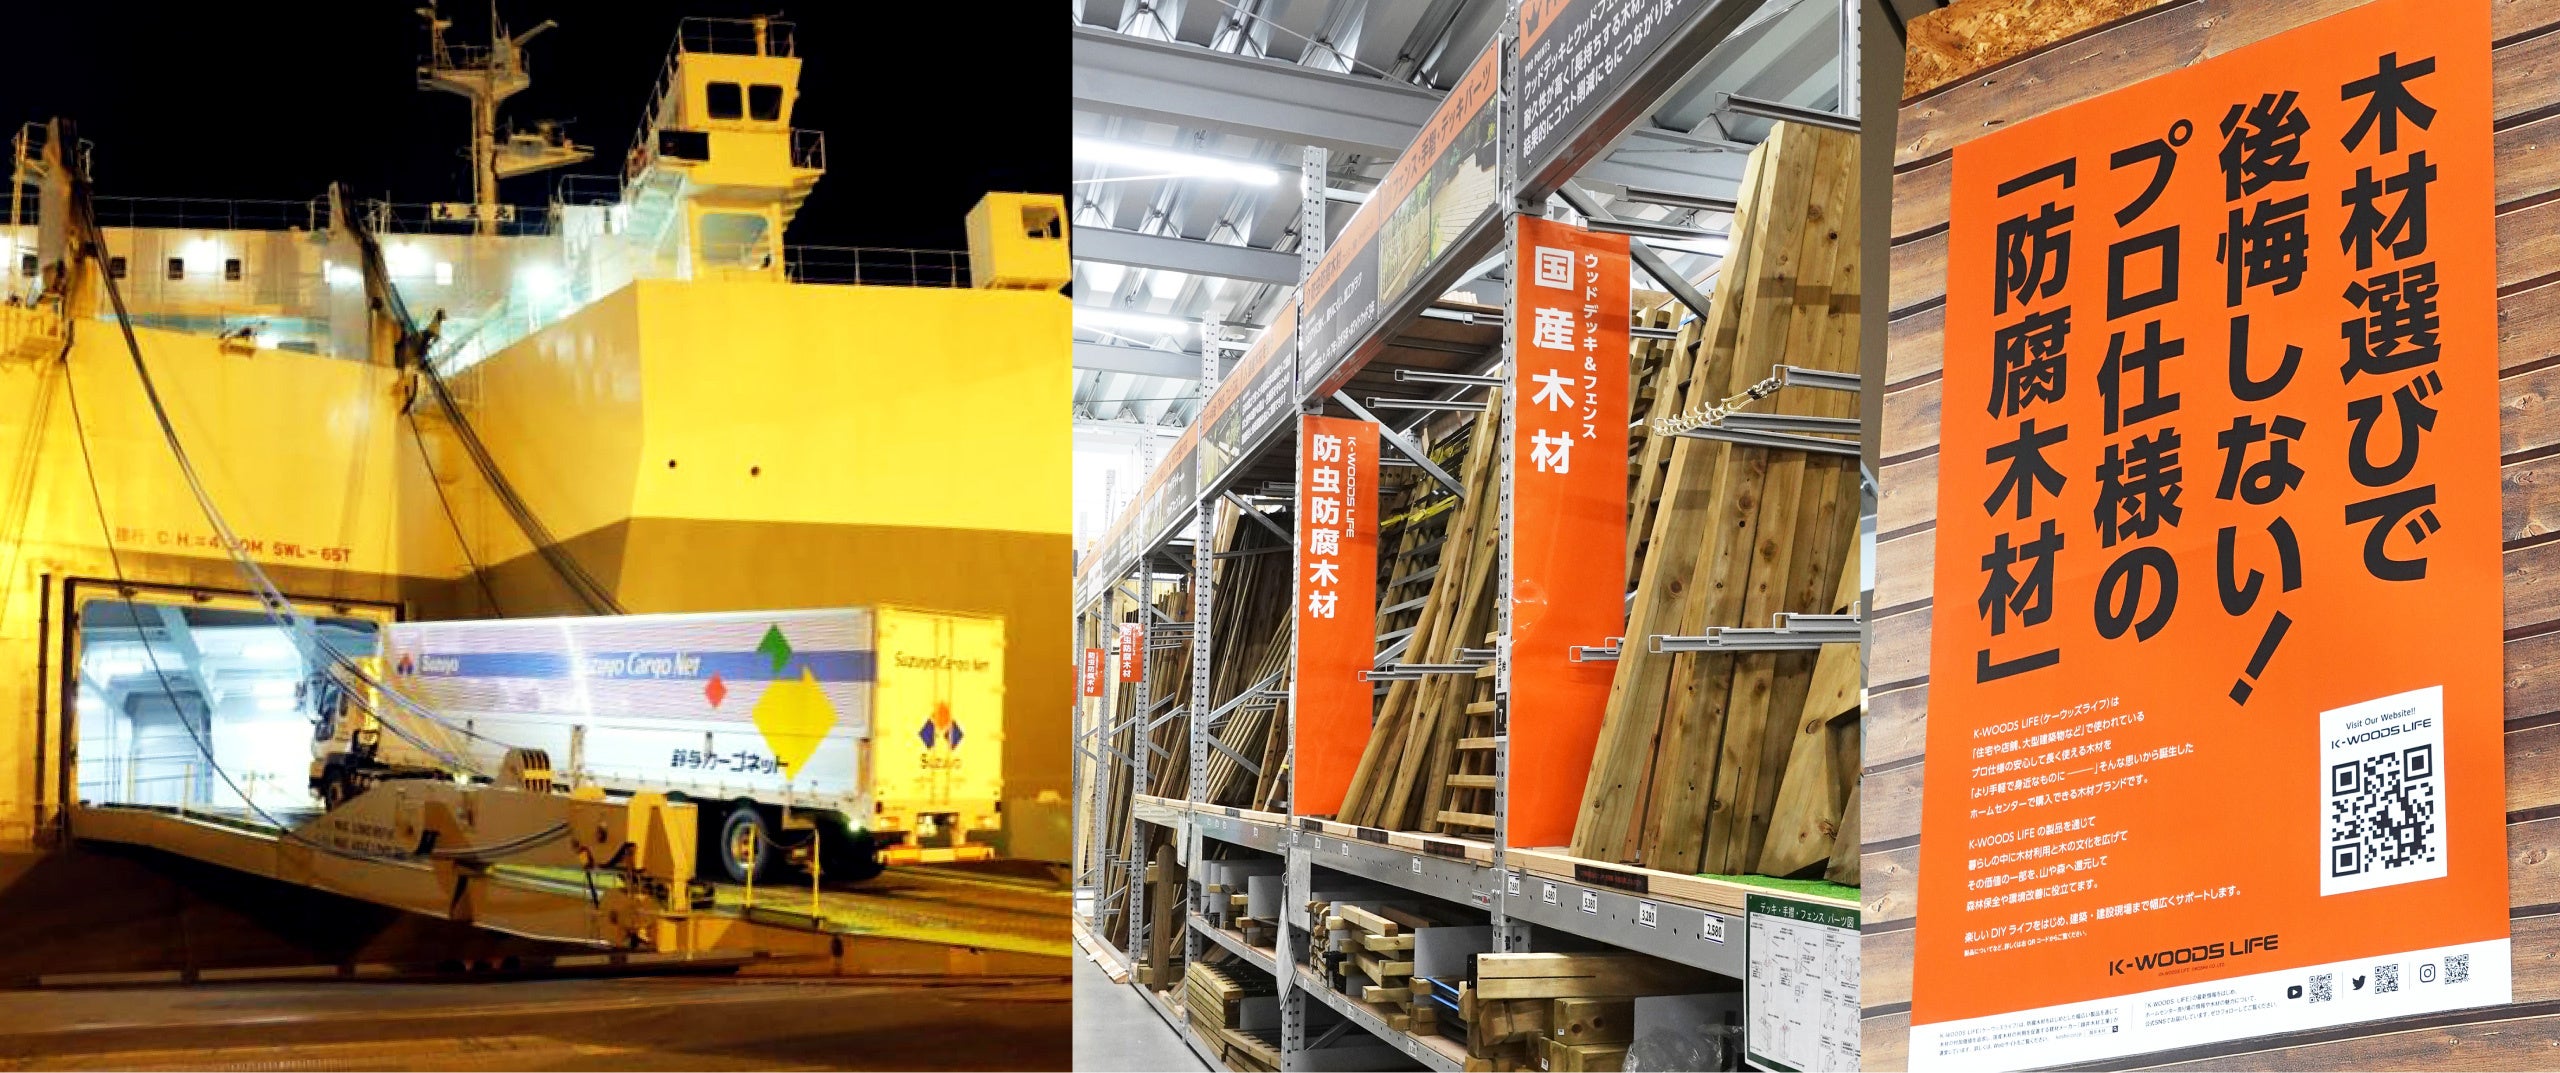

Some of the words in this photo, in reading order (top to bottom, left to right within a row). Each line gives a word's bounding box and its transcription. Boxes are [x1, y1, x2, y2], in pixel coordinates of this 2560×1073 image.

[1523, 0, 1681, 158] 結果的にコスト削減にもにつながりま
[2339, 51, 2442, 583] 木材選びで
[1530, 246, 1575, 474] 国産木材
[1582, 253, 1599, 439] ウッドデッキ&フェンス
[2092, 118, 2194, 643] プロ仕様の
[2214, 90, 2311, 706] 後悔しない！
[1976, 156, 2077, 685] 「防腐木材」
[1346, 436, 1357, 507] K-WOODS
[1308, 433, 1342, 619] 防虫防腐木材
[1345, 509, 1355, 538] LIFE
[626, 652, 673, 679] Cargo
[1973, 720, 2019, 739] K-WOODS
[2331, 725, 2400, 750] K-WOODS
[2402, 718, 2431, 733] LIFE
[2345, 720, 2362, 730] Visit
[2364, 717, 2378, 726] Our
[1968, 831, 2015, 850] K-WOODS
[2016, 828, 2036, 842] LIFE
[2037, 816, 2096, 836] の製品を通じて
[1827, 914, 1854, 928] パーツ図
[1991, 926, 2007, 938] DIY
[2109, 942, 2225, 976] K-WOODS
[2229, 934, 2279, 956] LIFE
